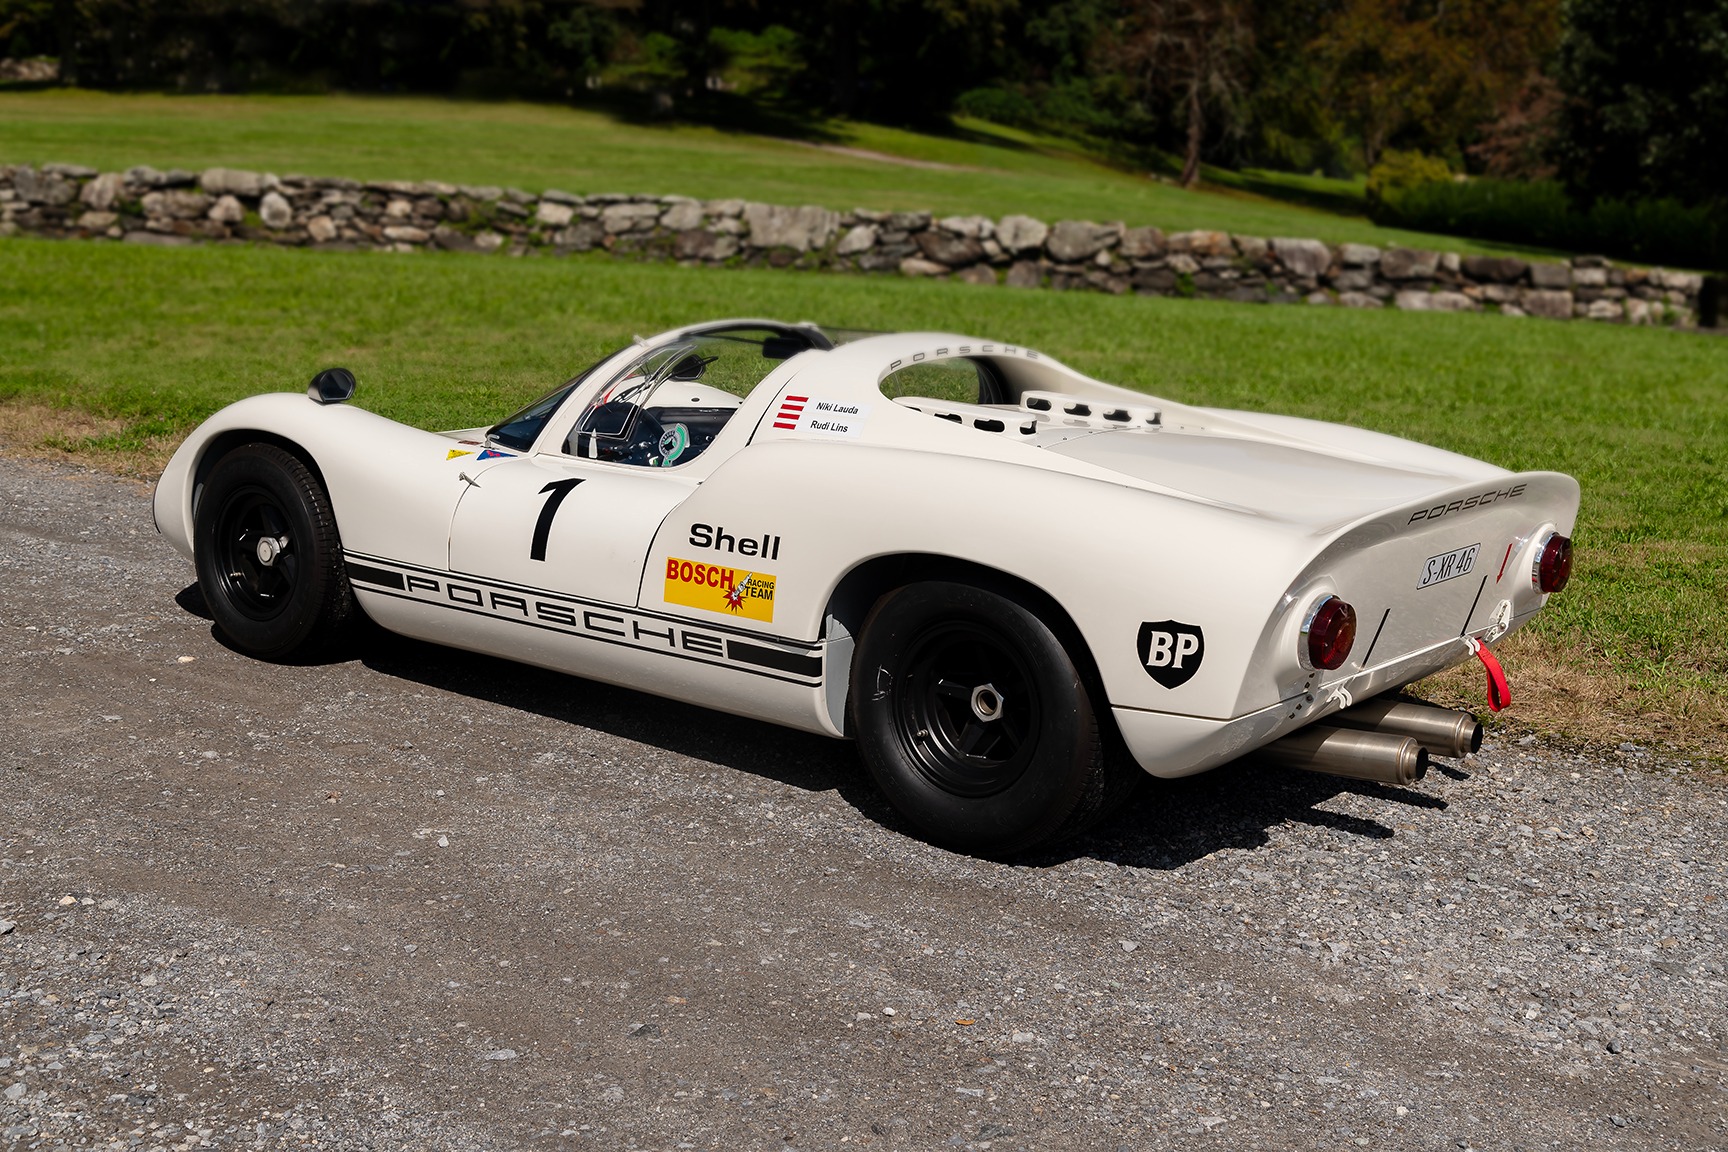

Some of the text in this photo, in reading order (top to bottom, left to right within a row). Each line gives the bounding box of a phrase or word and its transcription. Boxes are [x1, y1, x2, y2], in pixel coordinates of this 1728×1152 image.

[889, 344, 1039, 370] PORSCHE
[816, 402, 859, 415] Niki Lauda
[810, 420, 849, 433] Rudi Lins
[530, 477, 586, 562] 1
[1407, 483, 1527, 525] PORSCHE
[689, 523, 781, 560] Shell
[666, 559, 734, 591] BOSCH
[1422, 547, 1476, 585] S-XR 46
[745, 586, 774, 601] TEAM
[747, 578, 775, 590] RACING
[408, 574, 724, 657] PORSCHE
[1146, 630, 1199, 669] BP
